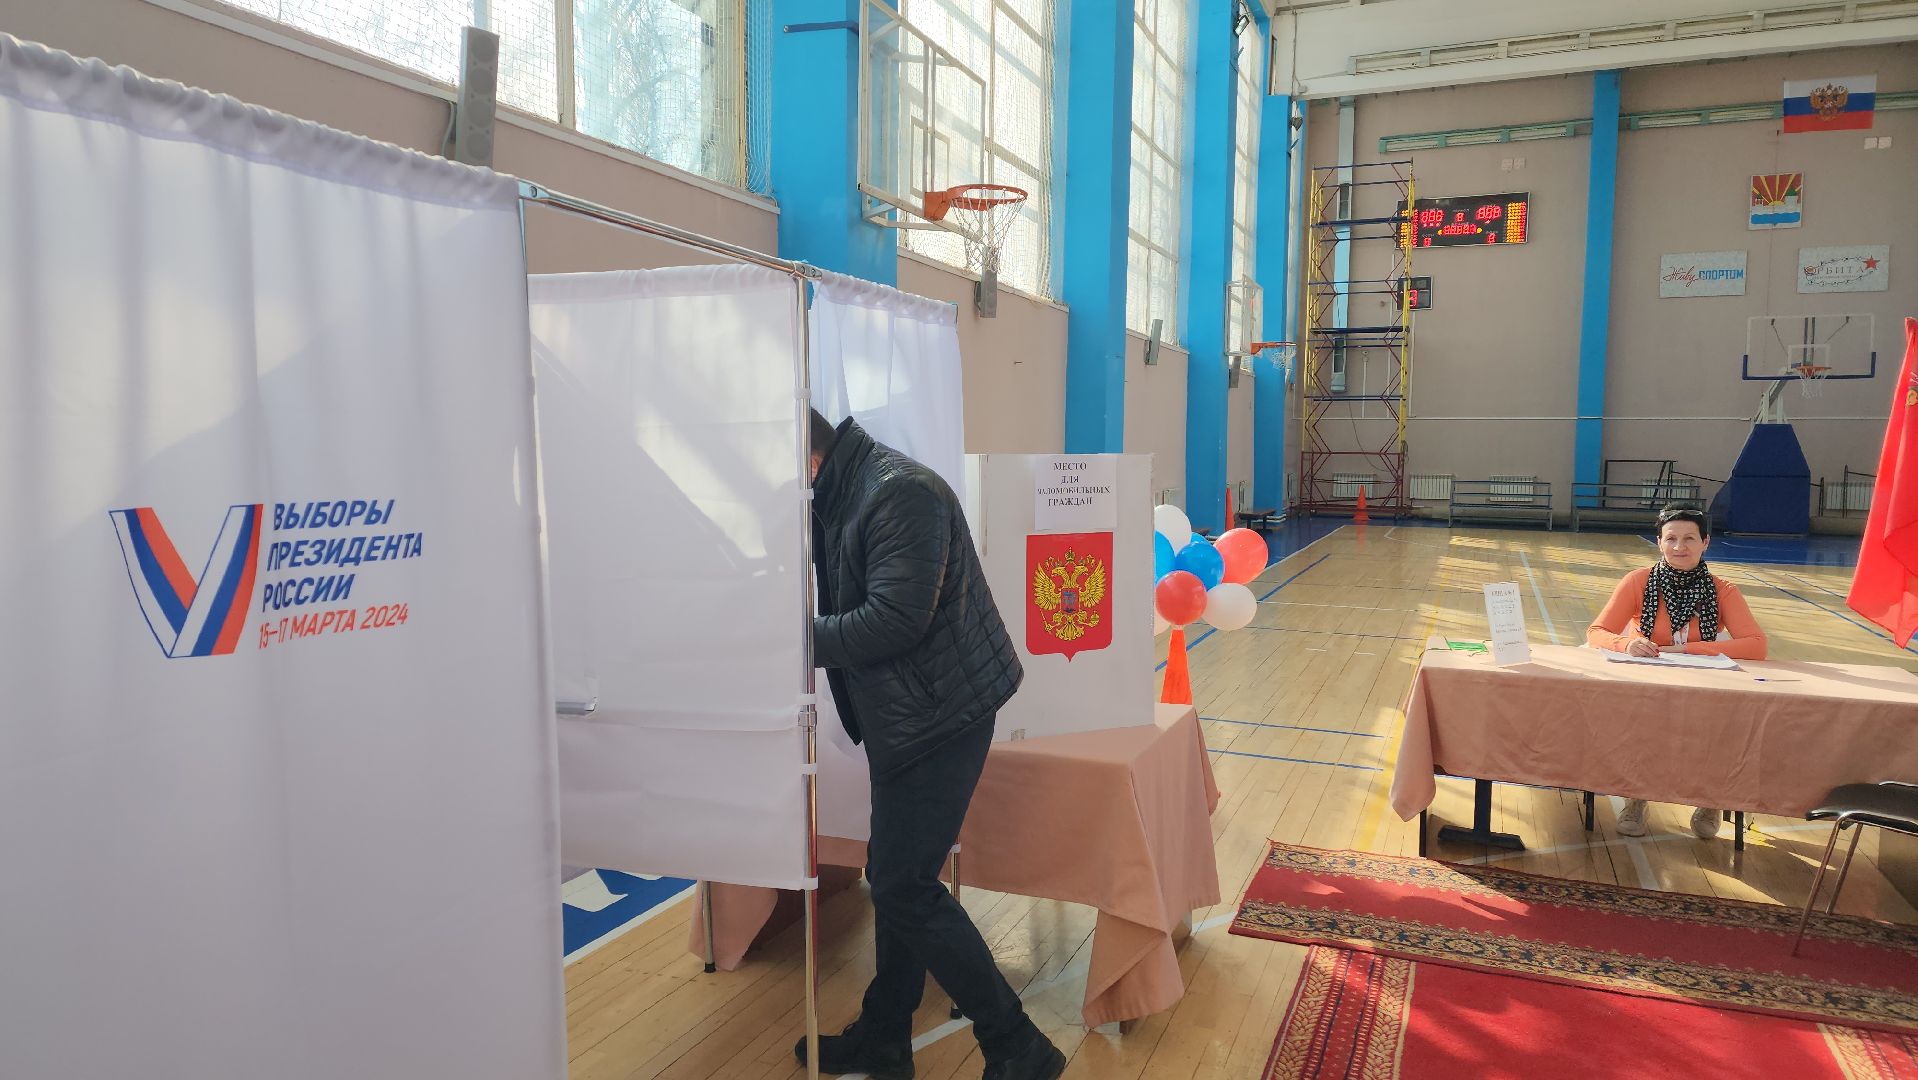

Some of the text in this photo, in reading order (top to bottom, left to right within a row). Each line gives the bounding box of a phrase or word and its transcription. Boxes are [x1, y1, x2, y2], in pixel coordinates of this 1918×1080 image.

[1698, 268, 1744, 280] СПОРТОМ
[1053, 462, 1087, 471] МЕСТО
[1060, 475, 1079, 484] ДЛЯ
[1048, 497, 1092, 506] ГРАЖДАН
[273, 499, 395, 531] ВЫБОРЫ
[266, 532, 423, 571] ПРЕЗИДЕНТА
[262, 573, 355, 612] РОССИИ
[290, 608, 357, 640] МАРТА
[360, 602, 409, 630] 2024
